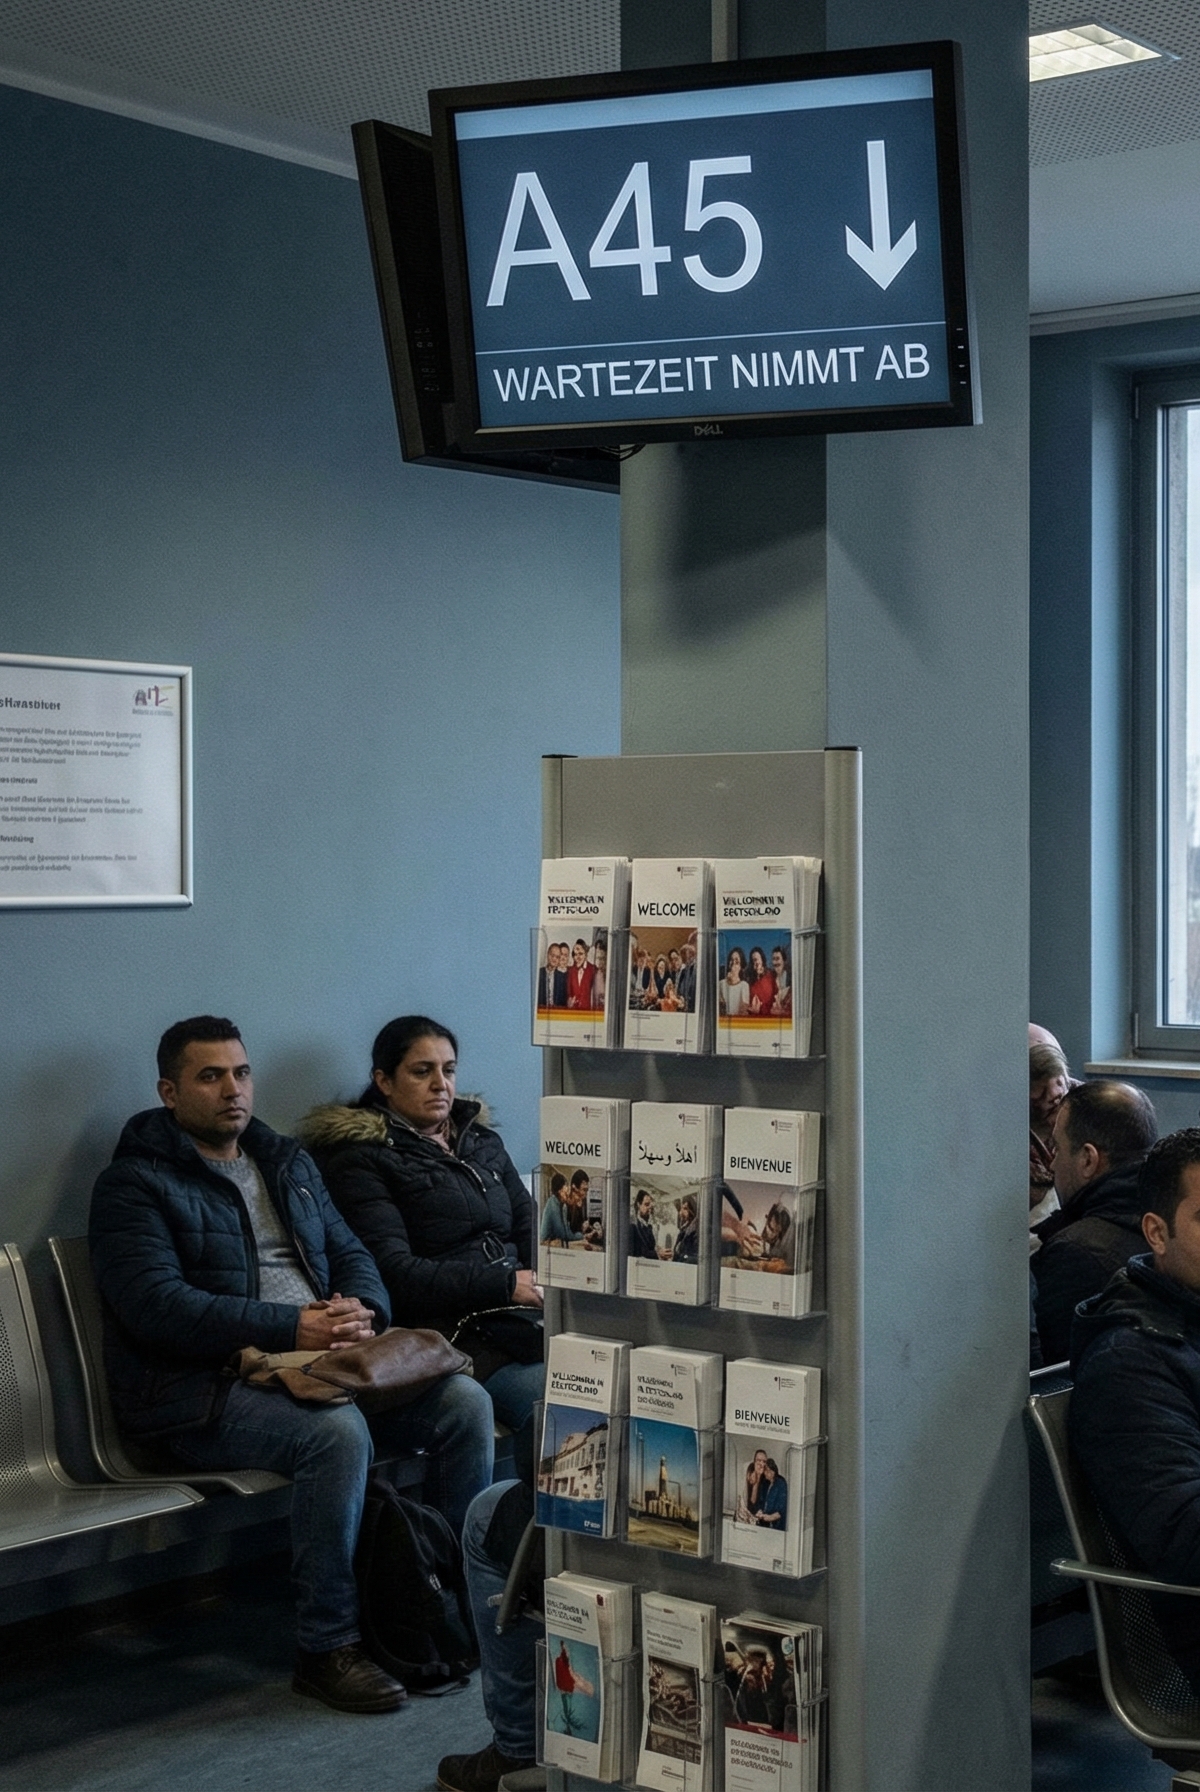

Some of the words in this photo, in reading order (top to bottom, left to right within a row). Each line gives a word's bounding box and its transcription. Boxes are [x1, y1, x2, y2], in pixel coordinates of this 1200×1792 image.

[486, 154, 764, 308] A45
[493, 355, 719, 402] WARTEZEIT
[731, 346, 865, 389] NIMMT
[875, 342, 931, 381] AB
[693, 423, 724, 437] DELL
[637, 901, 696, 917] WELCOME
[545, 1140, 602, 1157] WELCOME
[730, 1156, 792, 1174] BIENVENUE
[735, 1409, 791, 1427] BIENVENUE
